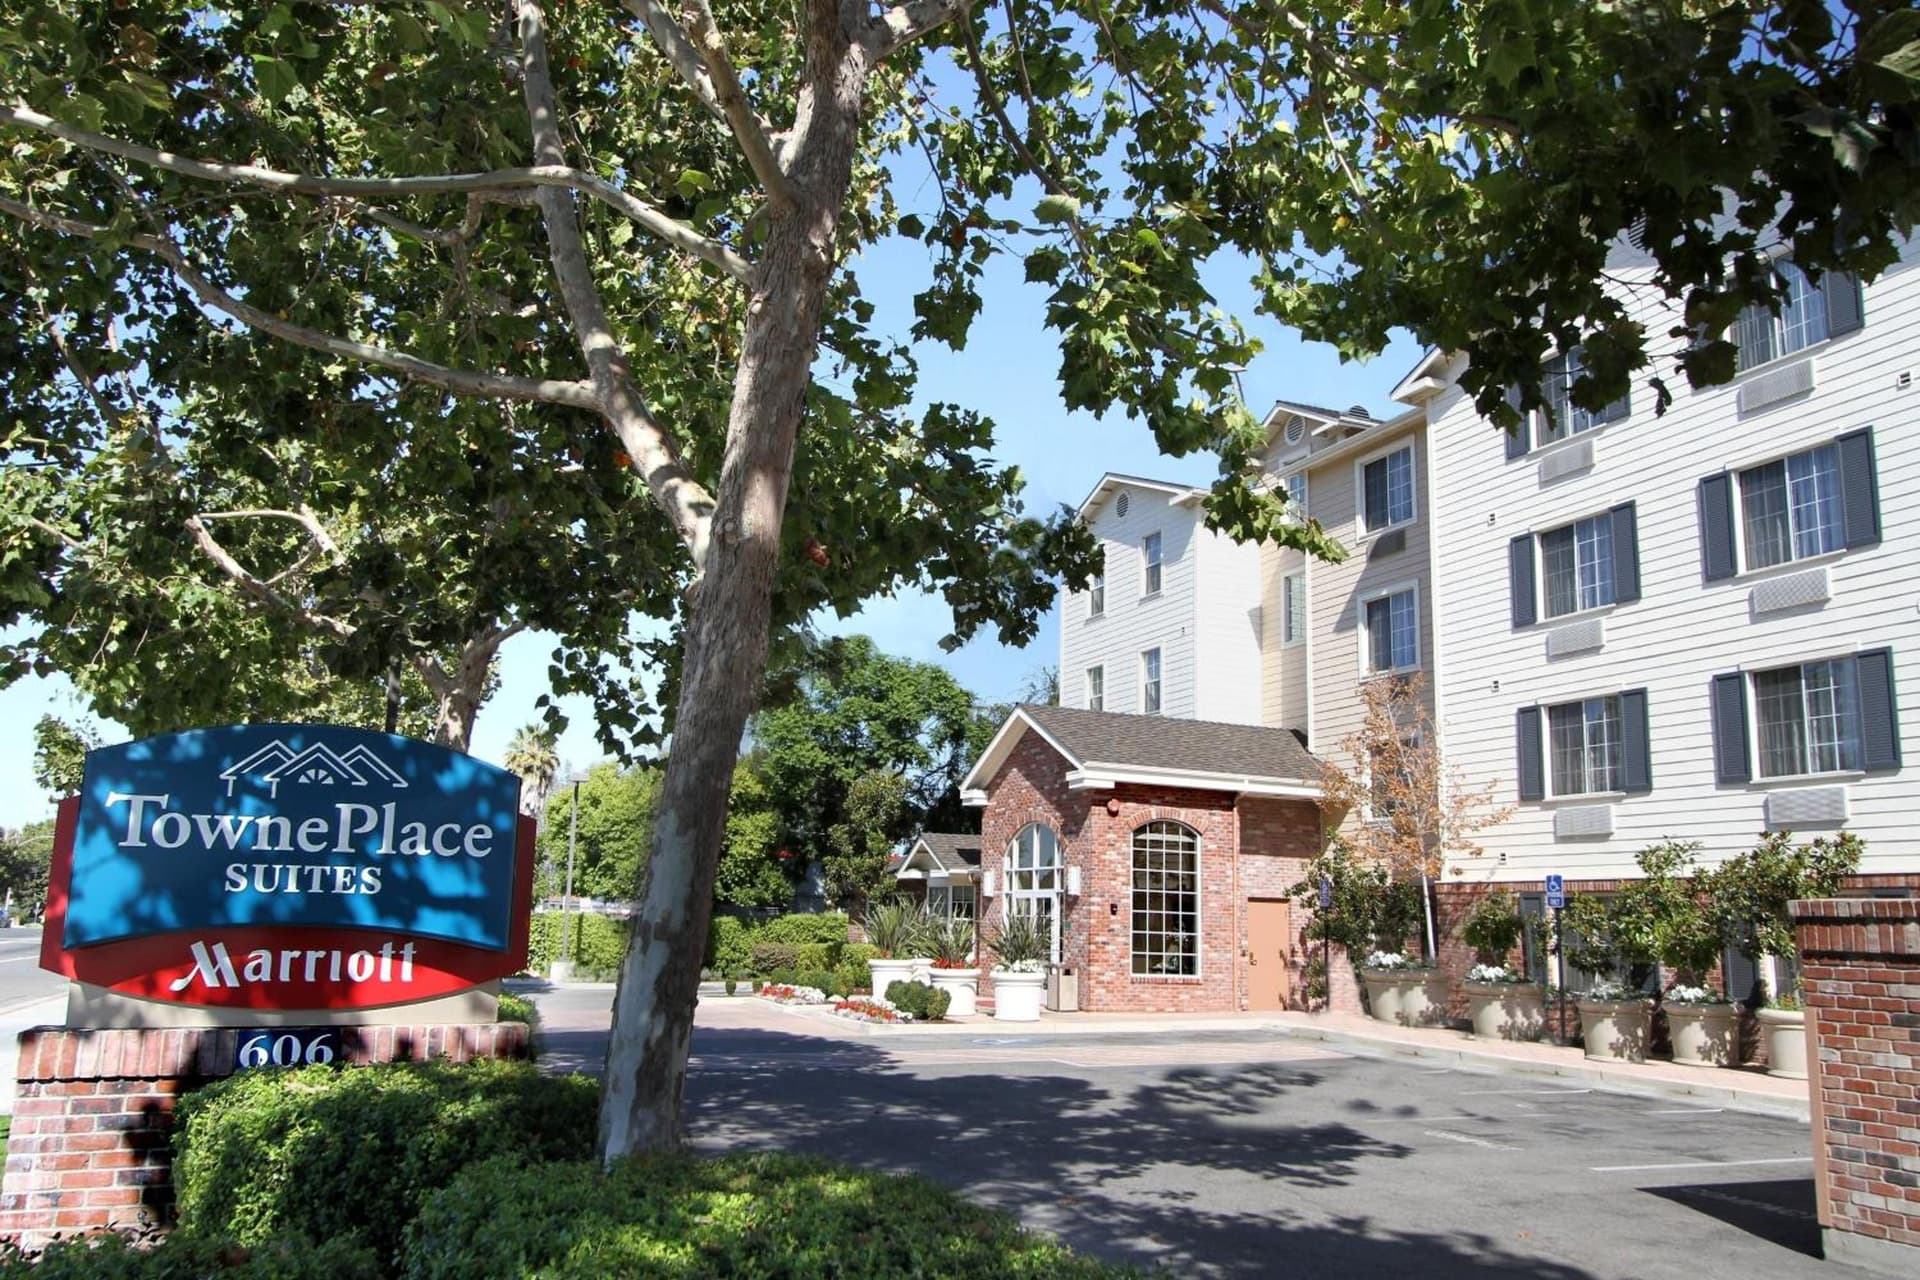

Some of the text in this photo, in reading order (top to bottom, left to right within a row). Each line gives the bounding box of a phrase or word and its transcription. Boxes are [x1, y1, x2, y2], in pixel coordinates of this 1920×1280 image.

[105, 791, 493, 857] TownePlace
[224, 863, 382, 895] SUITES
[169, 940, 416, 991] Marriott
[239, 1033, 334, 1068] 606
